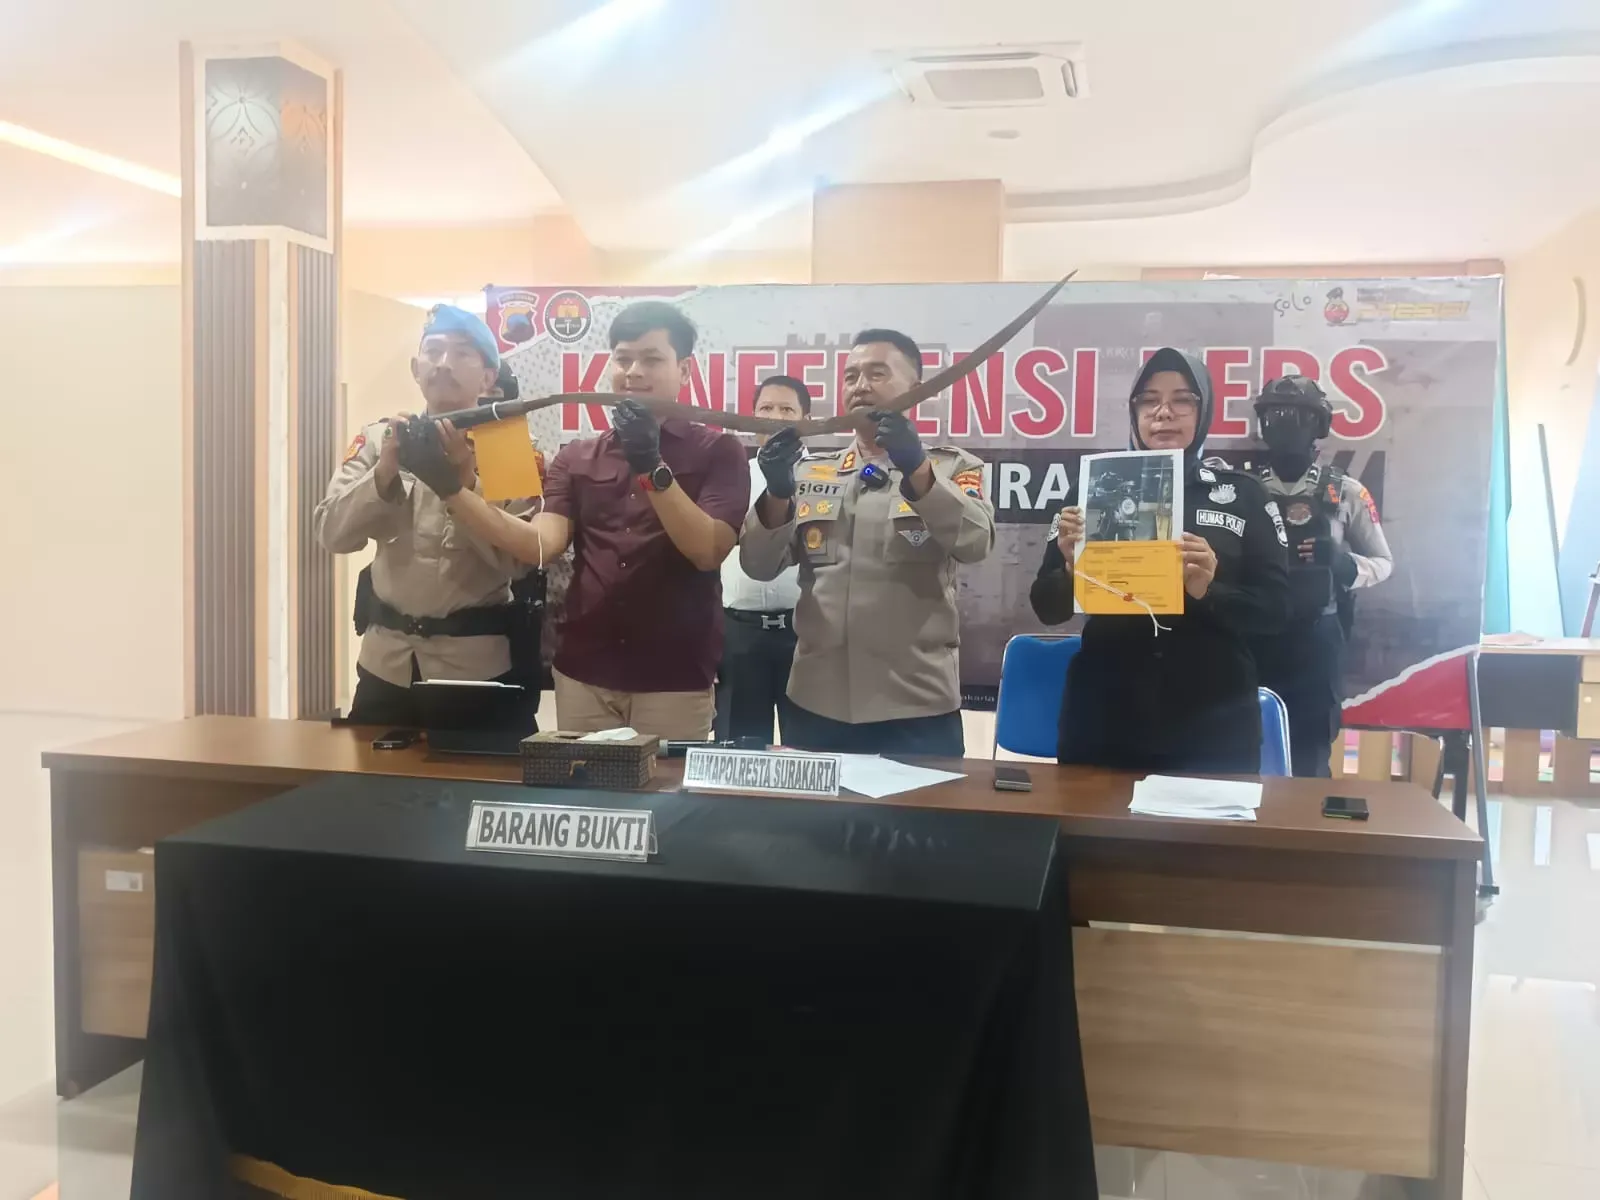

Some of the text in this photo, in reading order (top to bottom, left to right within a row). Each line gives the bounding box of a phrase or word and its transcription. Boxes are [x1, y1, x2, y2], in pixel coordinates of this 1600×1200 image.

[561, 345, 1099, 439] KNFEENSI
[773, 757, 836, 793] SURAKARTA
[479, 810, 647, 852] BARANG BUKTI
